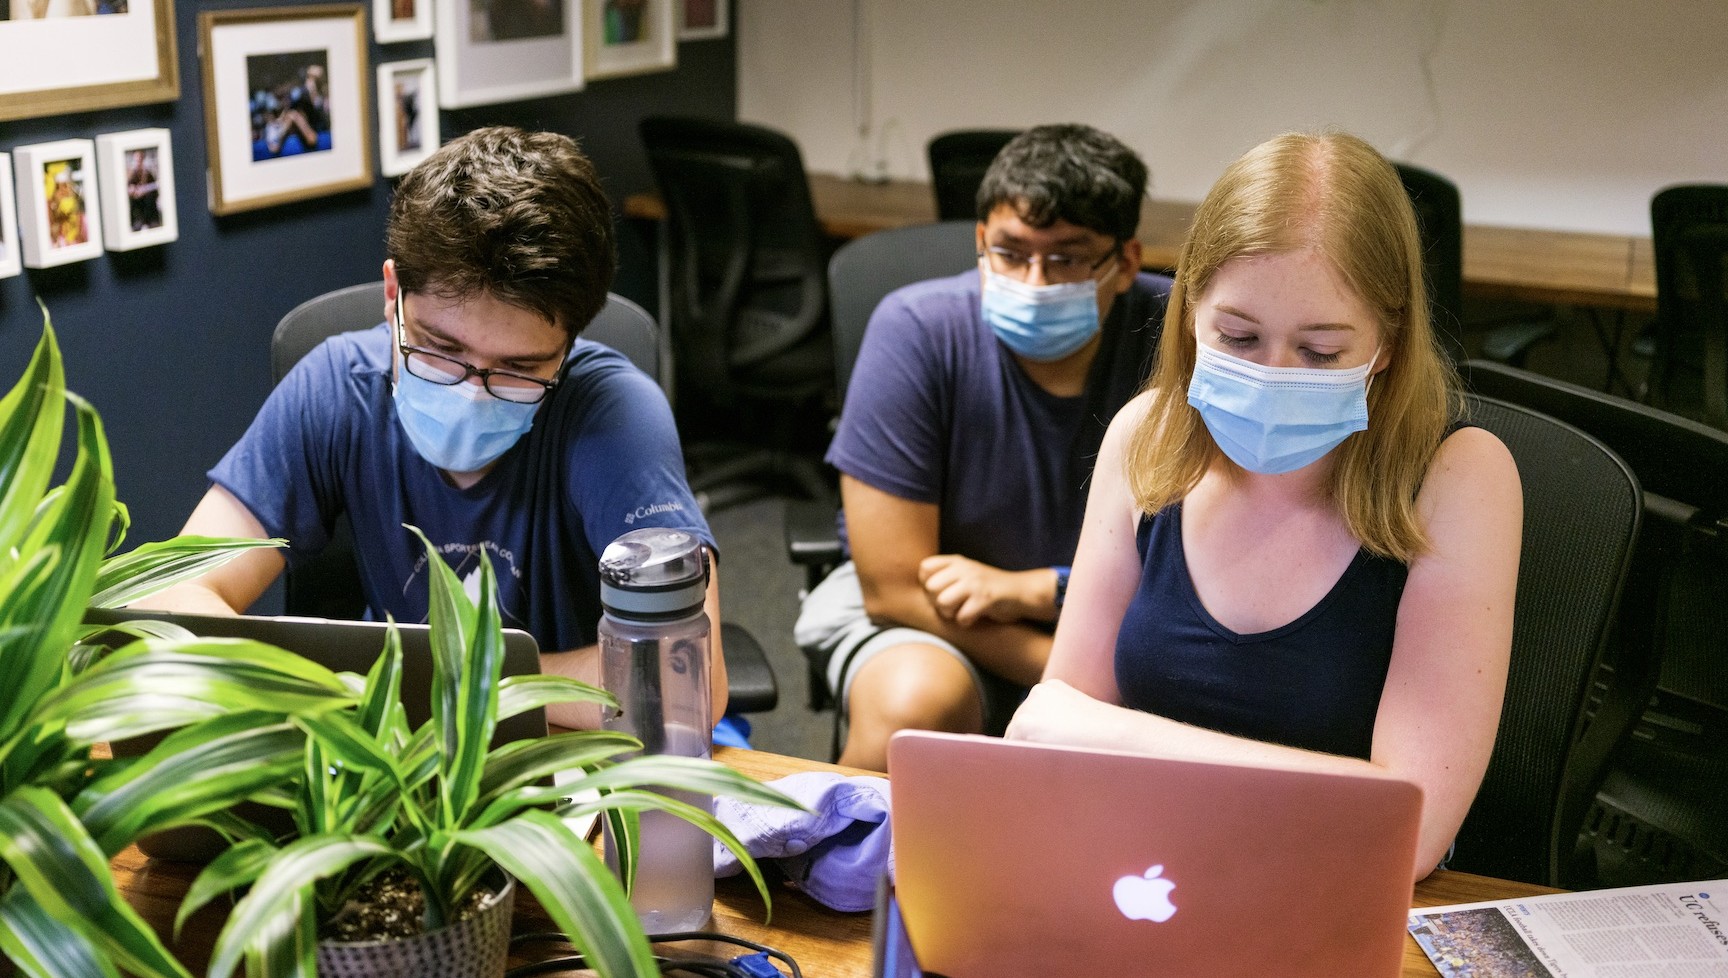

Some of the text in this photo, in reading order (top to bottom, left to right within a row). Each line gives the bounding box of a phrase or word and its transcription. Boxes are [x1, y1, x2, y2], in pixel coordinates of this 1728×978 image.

[635, 501, 684, 519] Columbia
[444, 540, 499, 555] SPORTSEAR
[1679, 894, 1704, 910] UC
[1693, 912, 1728, 946] refuses
